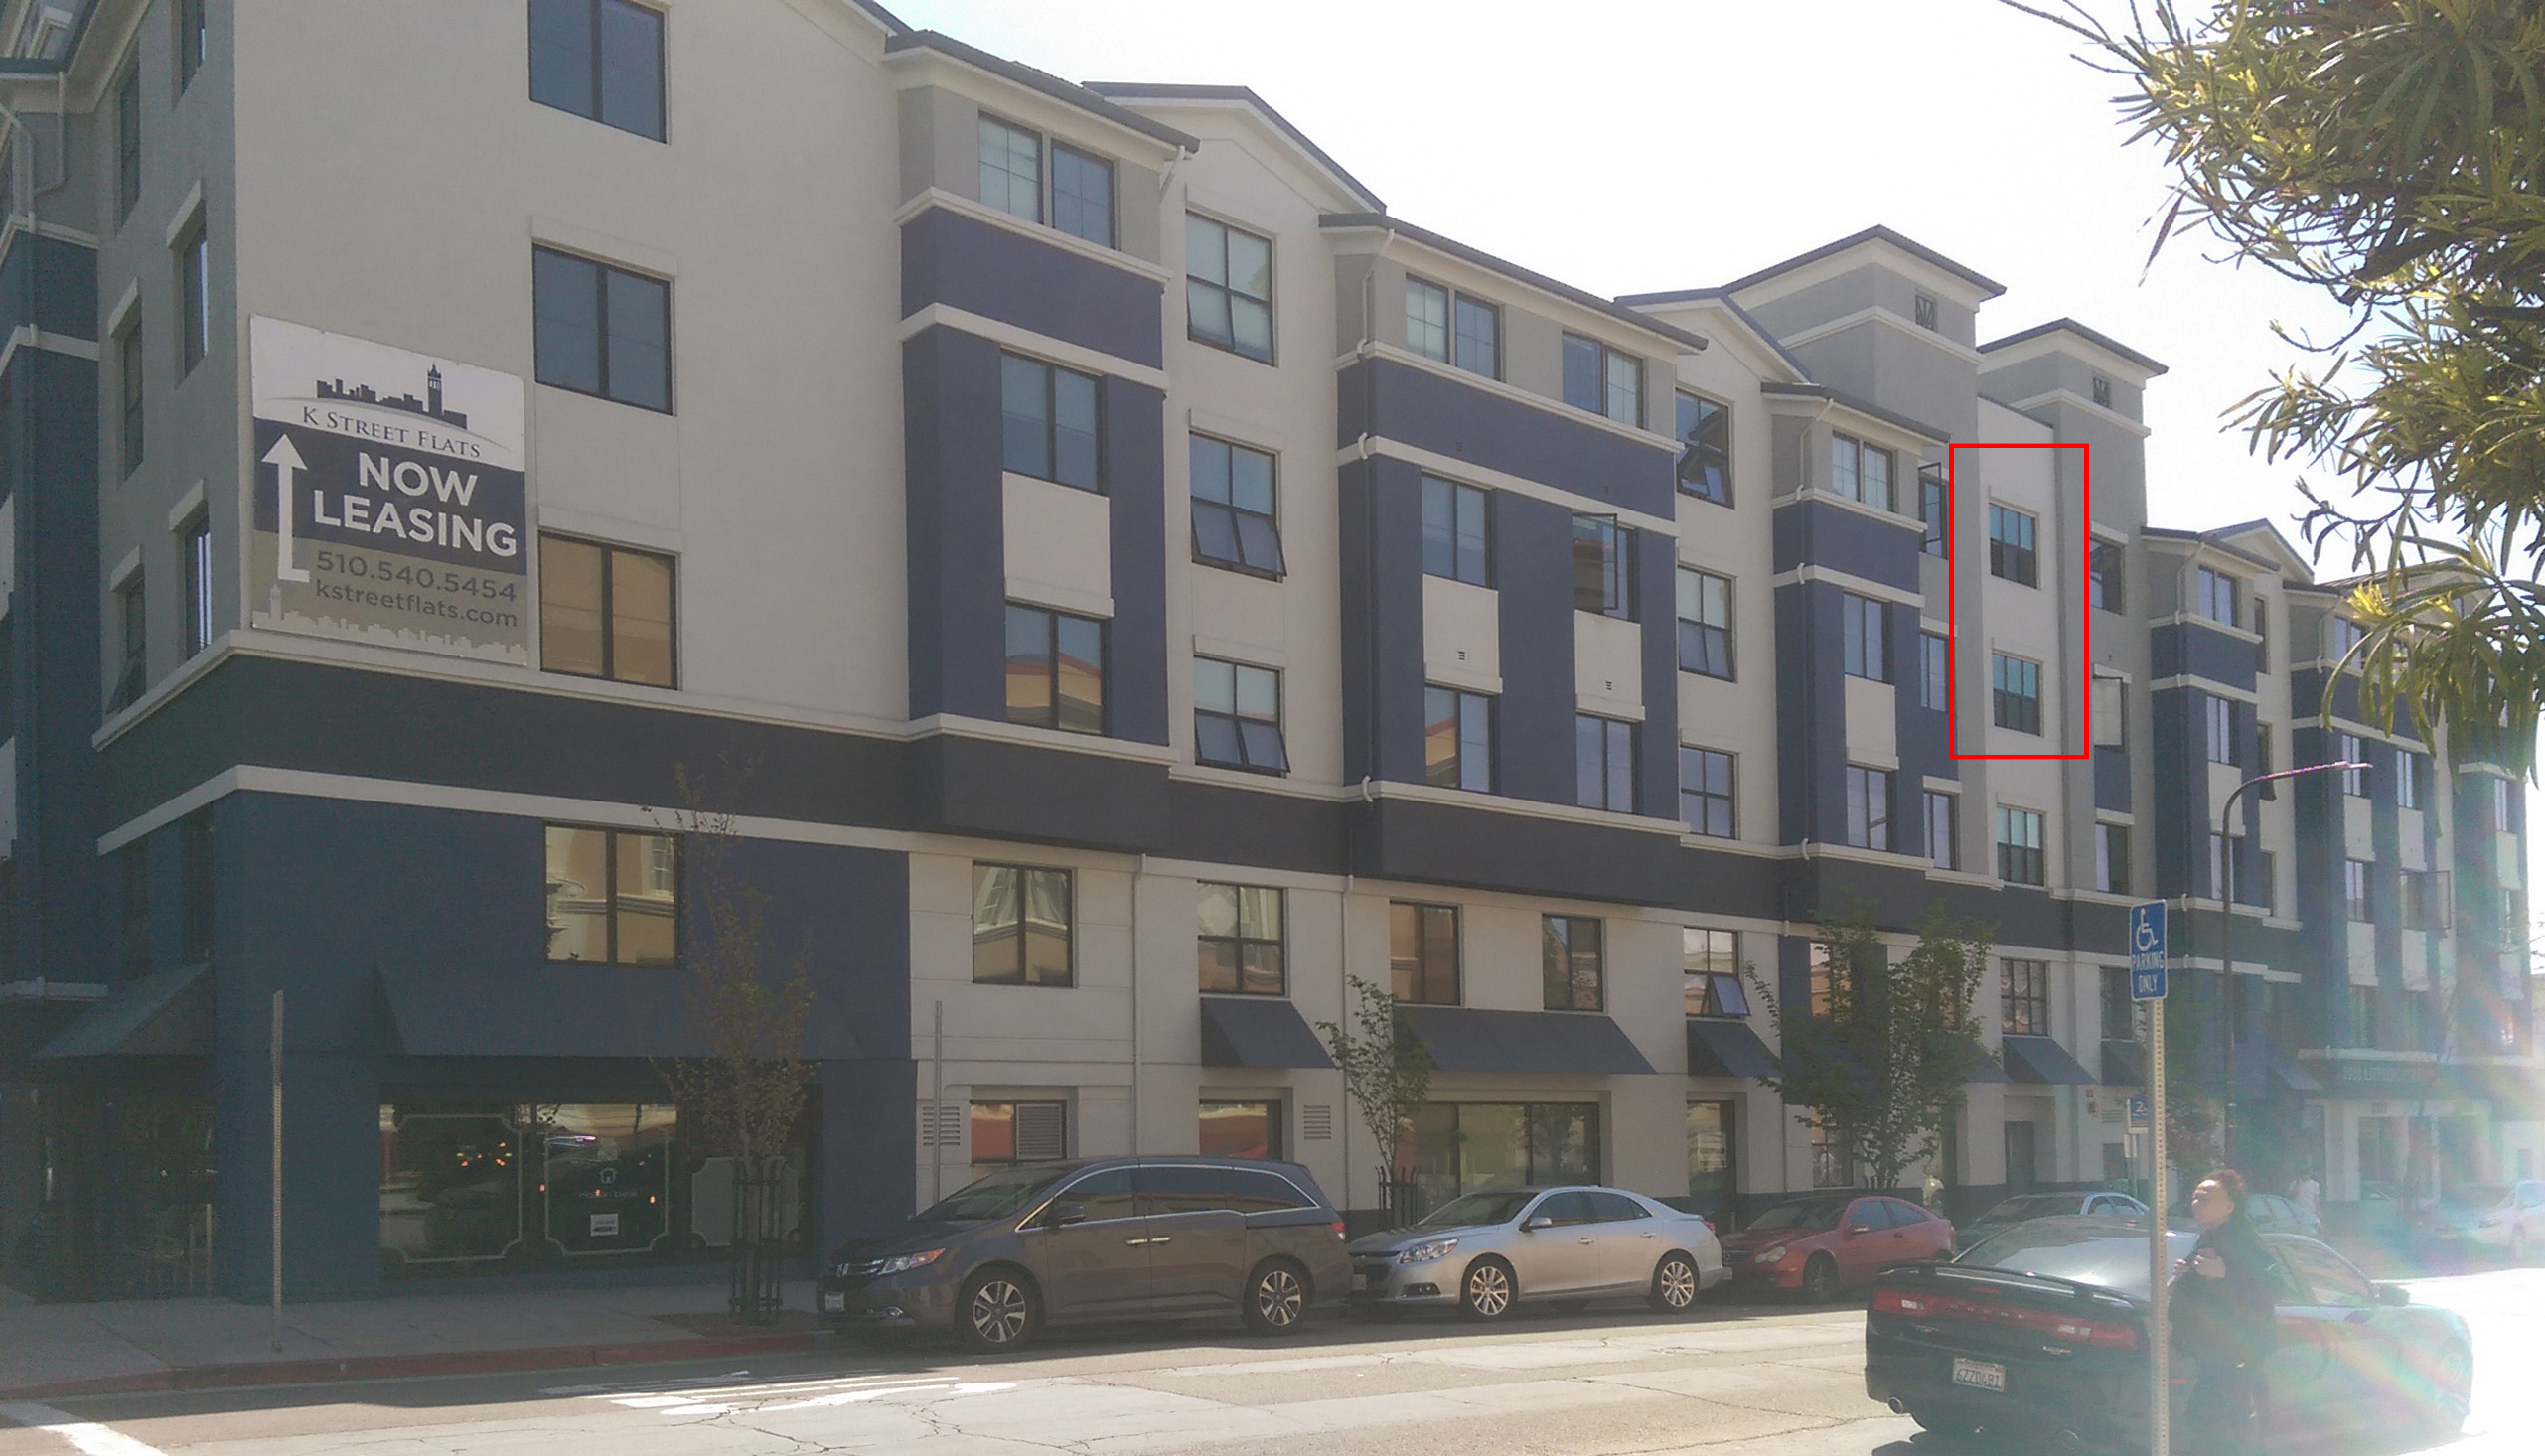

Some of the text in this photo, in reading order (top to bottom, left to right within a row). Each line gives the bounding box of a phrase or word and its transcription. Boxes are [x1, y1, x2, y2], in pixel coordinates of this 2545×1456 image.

[303, 406, 481, 458] K STREET FLATS
[359, 452, 478, 506] NOW
[313, 490, 517, 557] LEASING
[317, 550, 517, 601] 510.540.5454
[317, 580, 518, 627] kstreetflats.com
[2132, 951, 2165, 971] PARKING
[2138, 974, 2158, 993] ONLY
